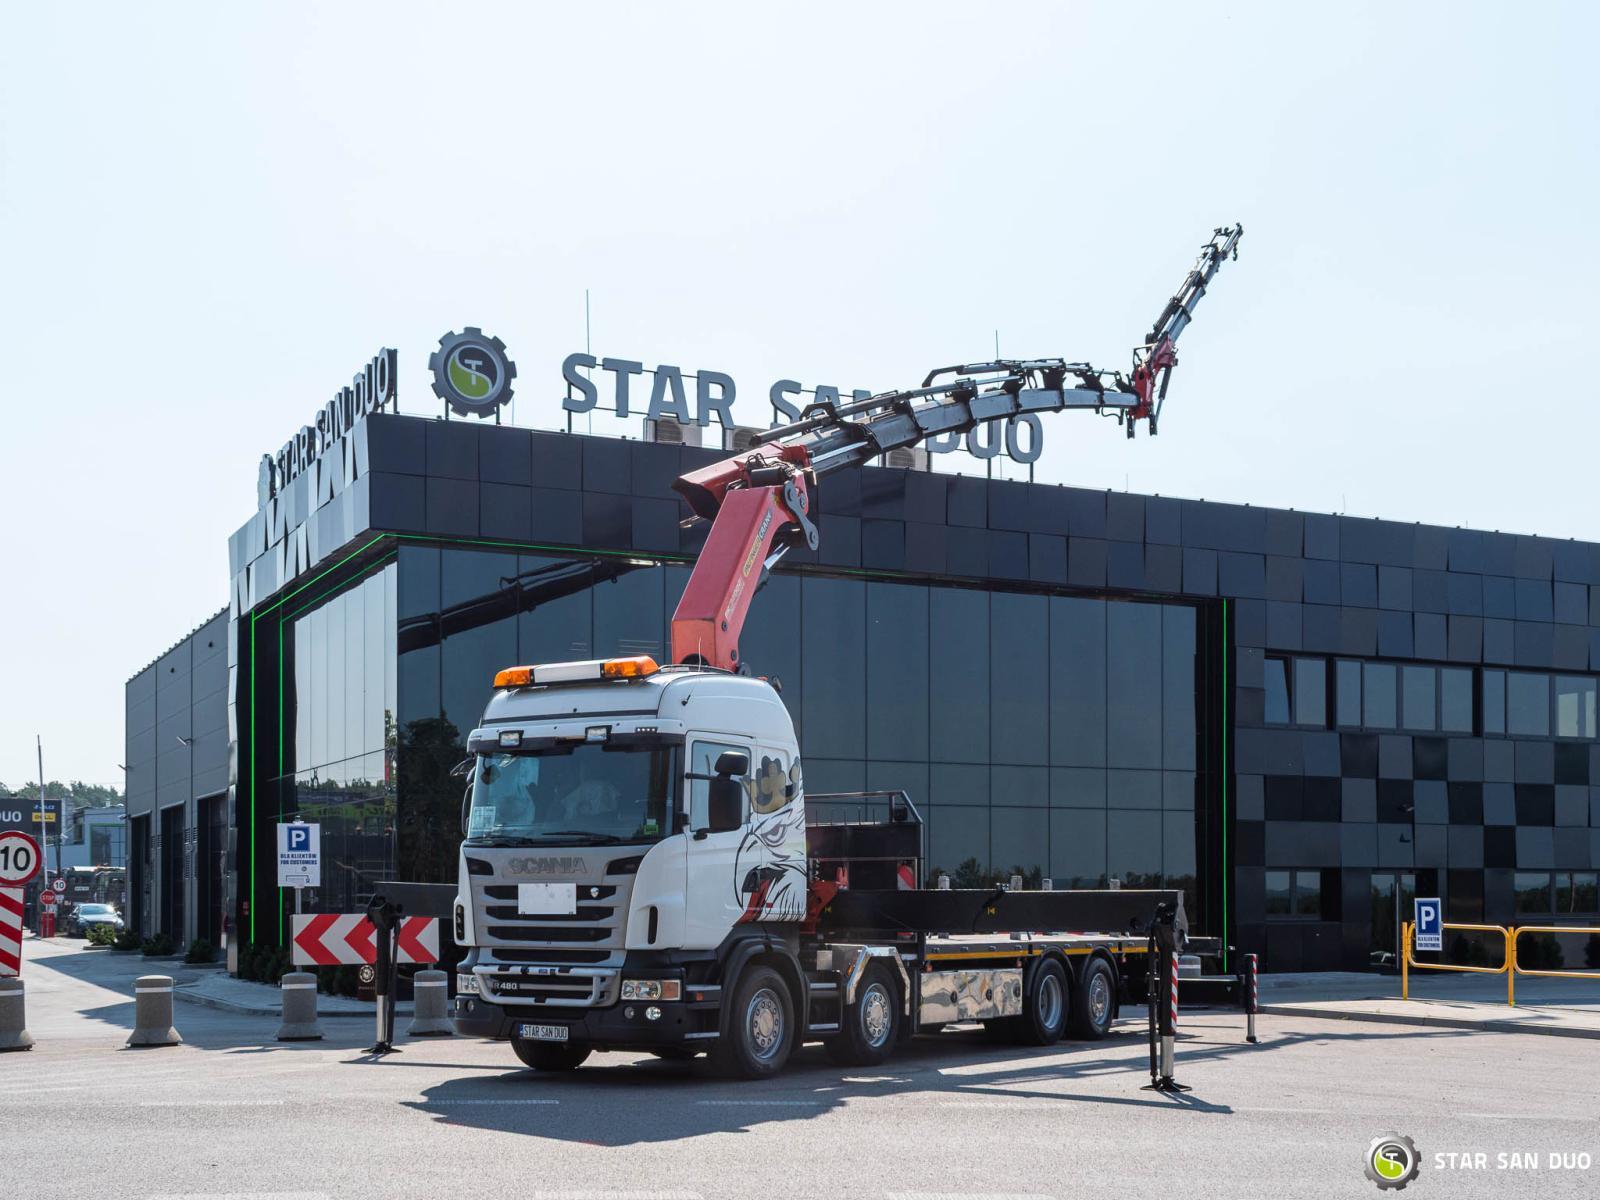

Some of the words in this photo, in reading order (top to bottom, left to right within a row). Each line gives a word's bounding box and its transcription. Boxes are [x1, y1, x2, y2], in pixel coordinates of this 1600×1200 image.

[353, 347, 389, 420] DUO
[562, 353, 736, 429] STAR
[0, 810, 22, 822] UO
[291, 829, 305, 848] P
[0, 846, 31, 872] 10
[511, 856, 588, 874] SCANIA
[1420, 906, 1435, 930] P
[524, 1025, 540, 1037] STAR
[541, 1027, 554, 1038] SAN
[555, 1027, 568, 1039] DUO
